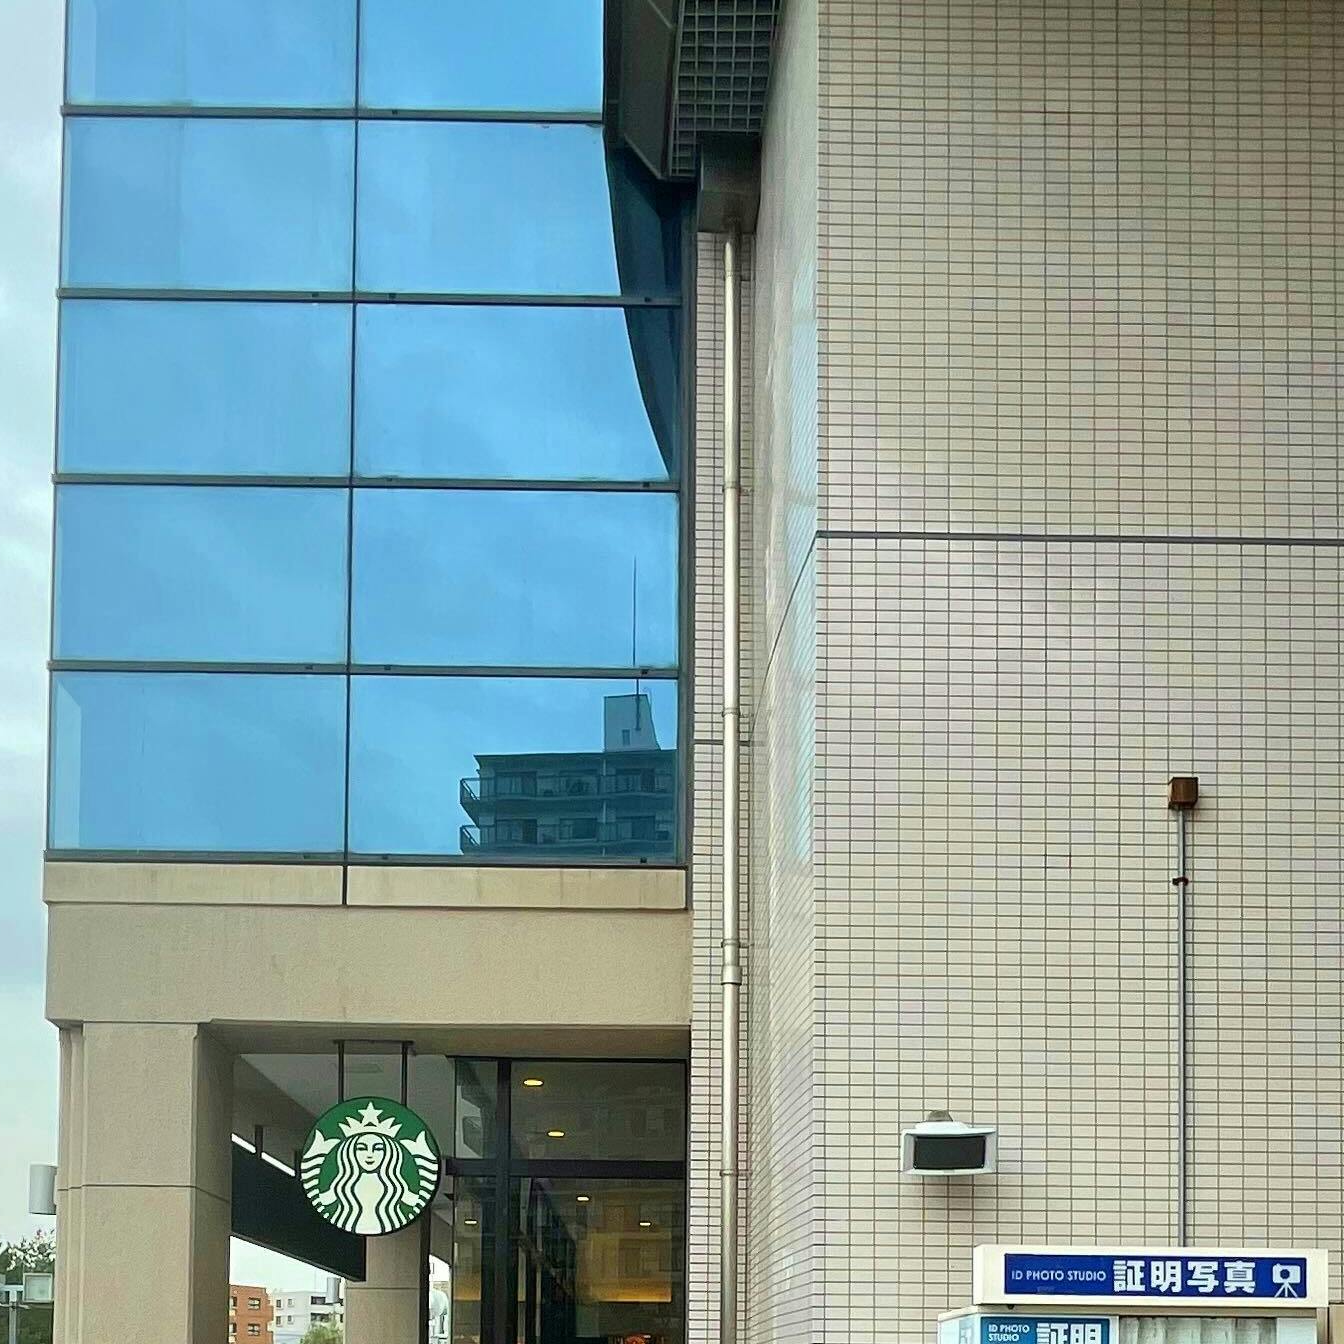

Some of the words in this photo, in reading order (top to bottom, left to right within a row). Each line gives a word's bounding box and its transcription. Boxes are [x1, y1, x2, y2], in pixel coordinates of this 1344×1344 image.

[1011, 1270, 1023, 1280] ID
[1026, 1270, 1064, 1281] PHOTO
[1067, 1270, 1106, 1281] STUDIO
[1113, 1260, 1256, 1293] 証明写真
[988, 1324, 998, 1333] ID
[1000, 1324, 1030, 1333] PHOTO
[988, 1333, 1020, 1342] STUDIO
